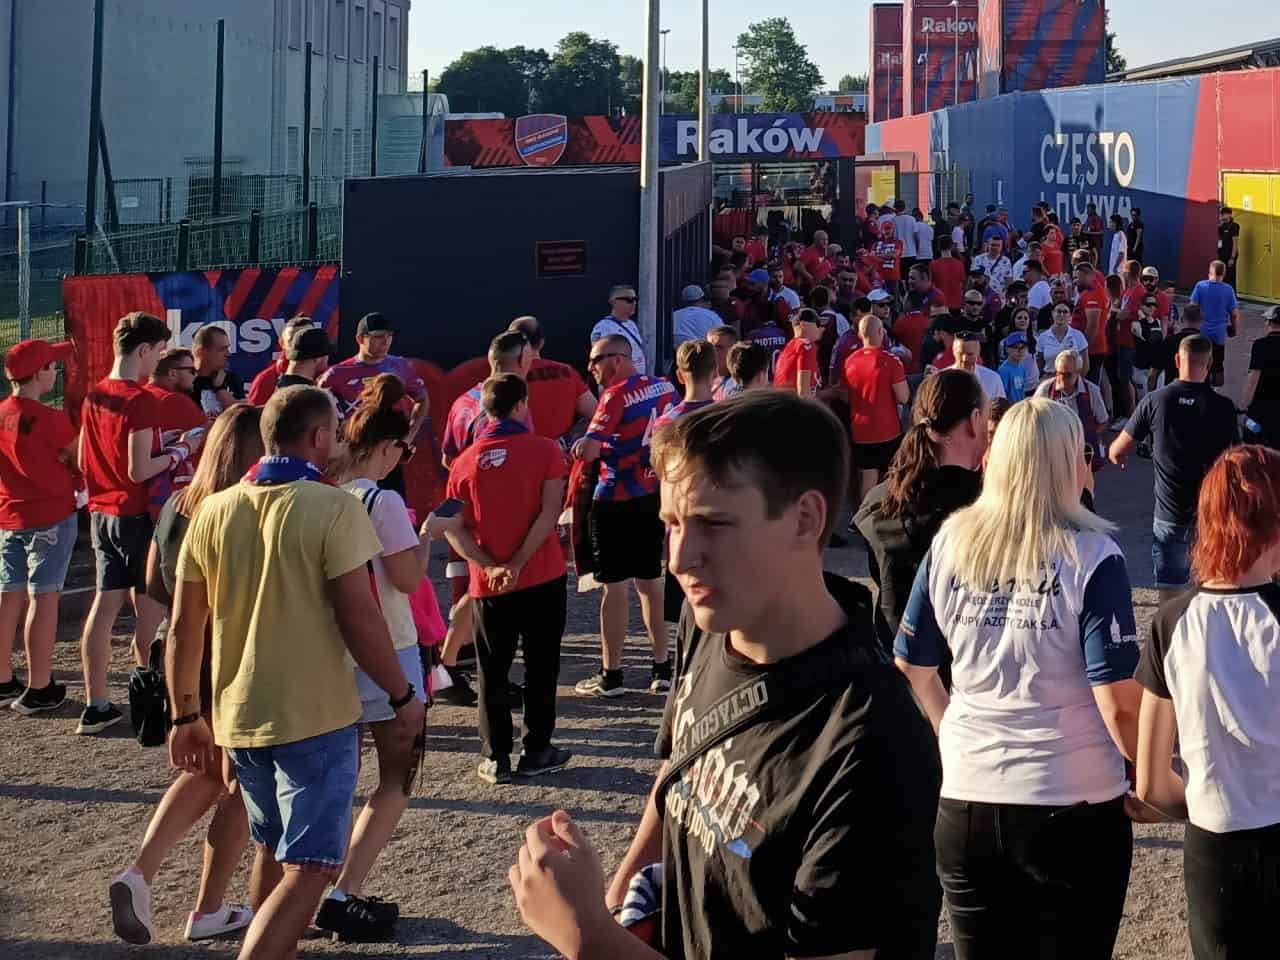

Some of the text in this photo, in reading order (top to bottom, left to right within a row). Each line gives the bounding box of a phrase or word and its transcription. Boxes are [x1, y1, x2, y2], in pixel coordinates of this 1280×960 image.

[676, 118, 824, 155] Raków
[1040, 131, 1135, 192] CZĘSTO
[690, 680, 769, 748] OCTAGON
